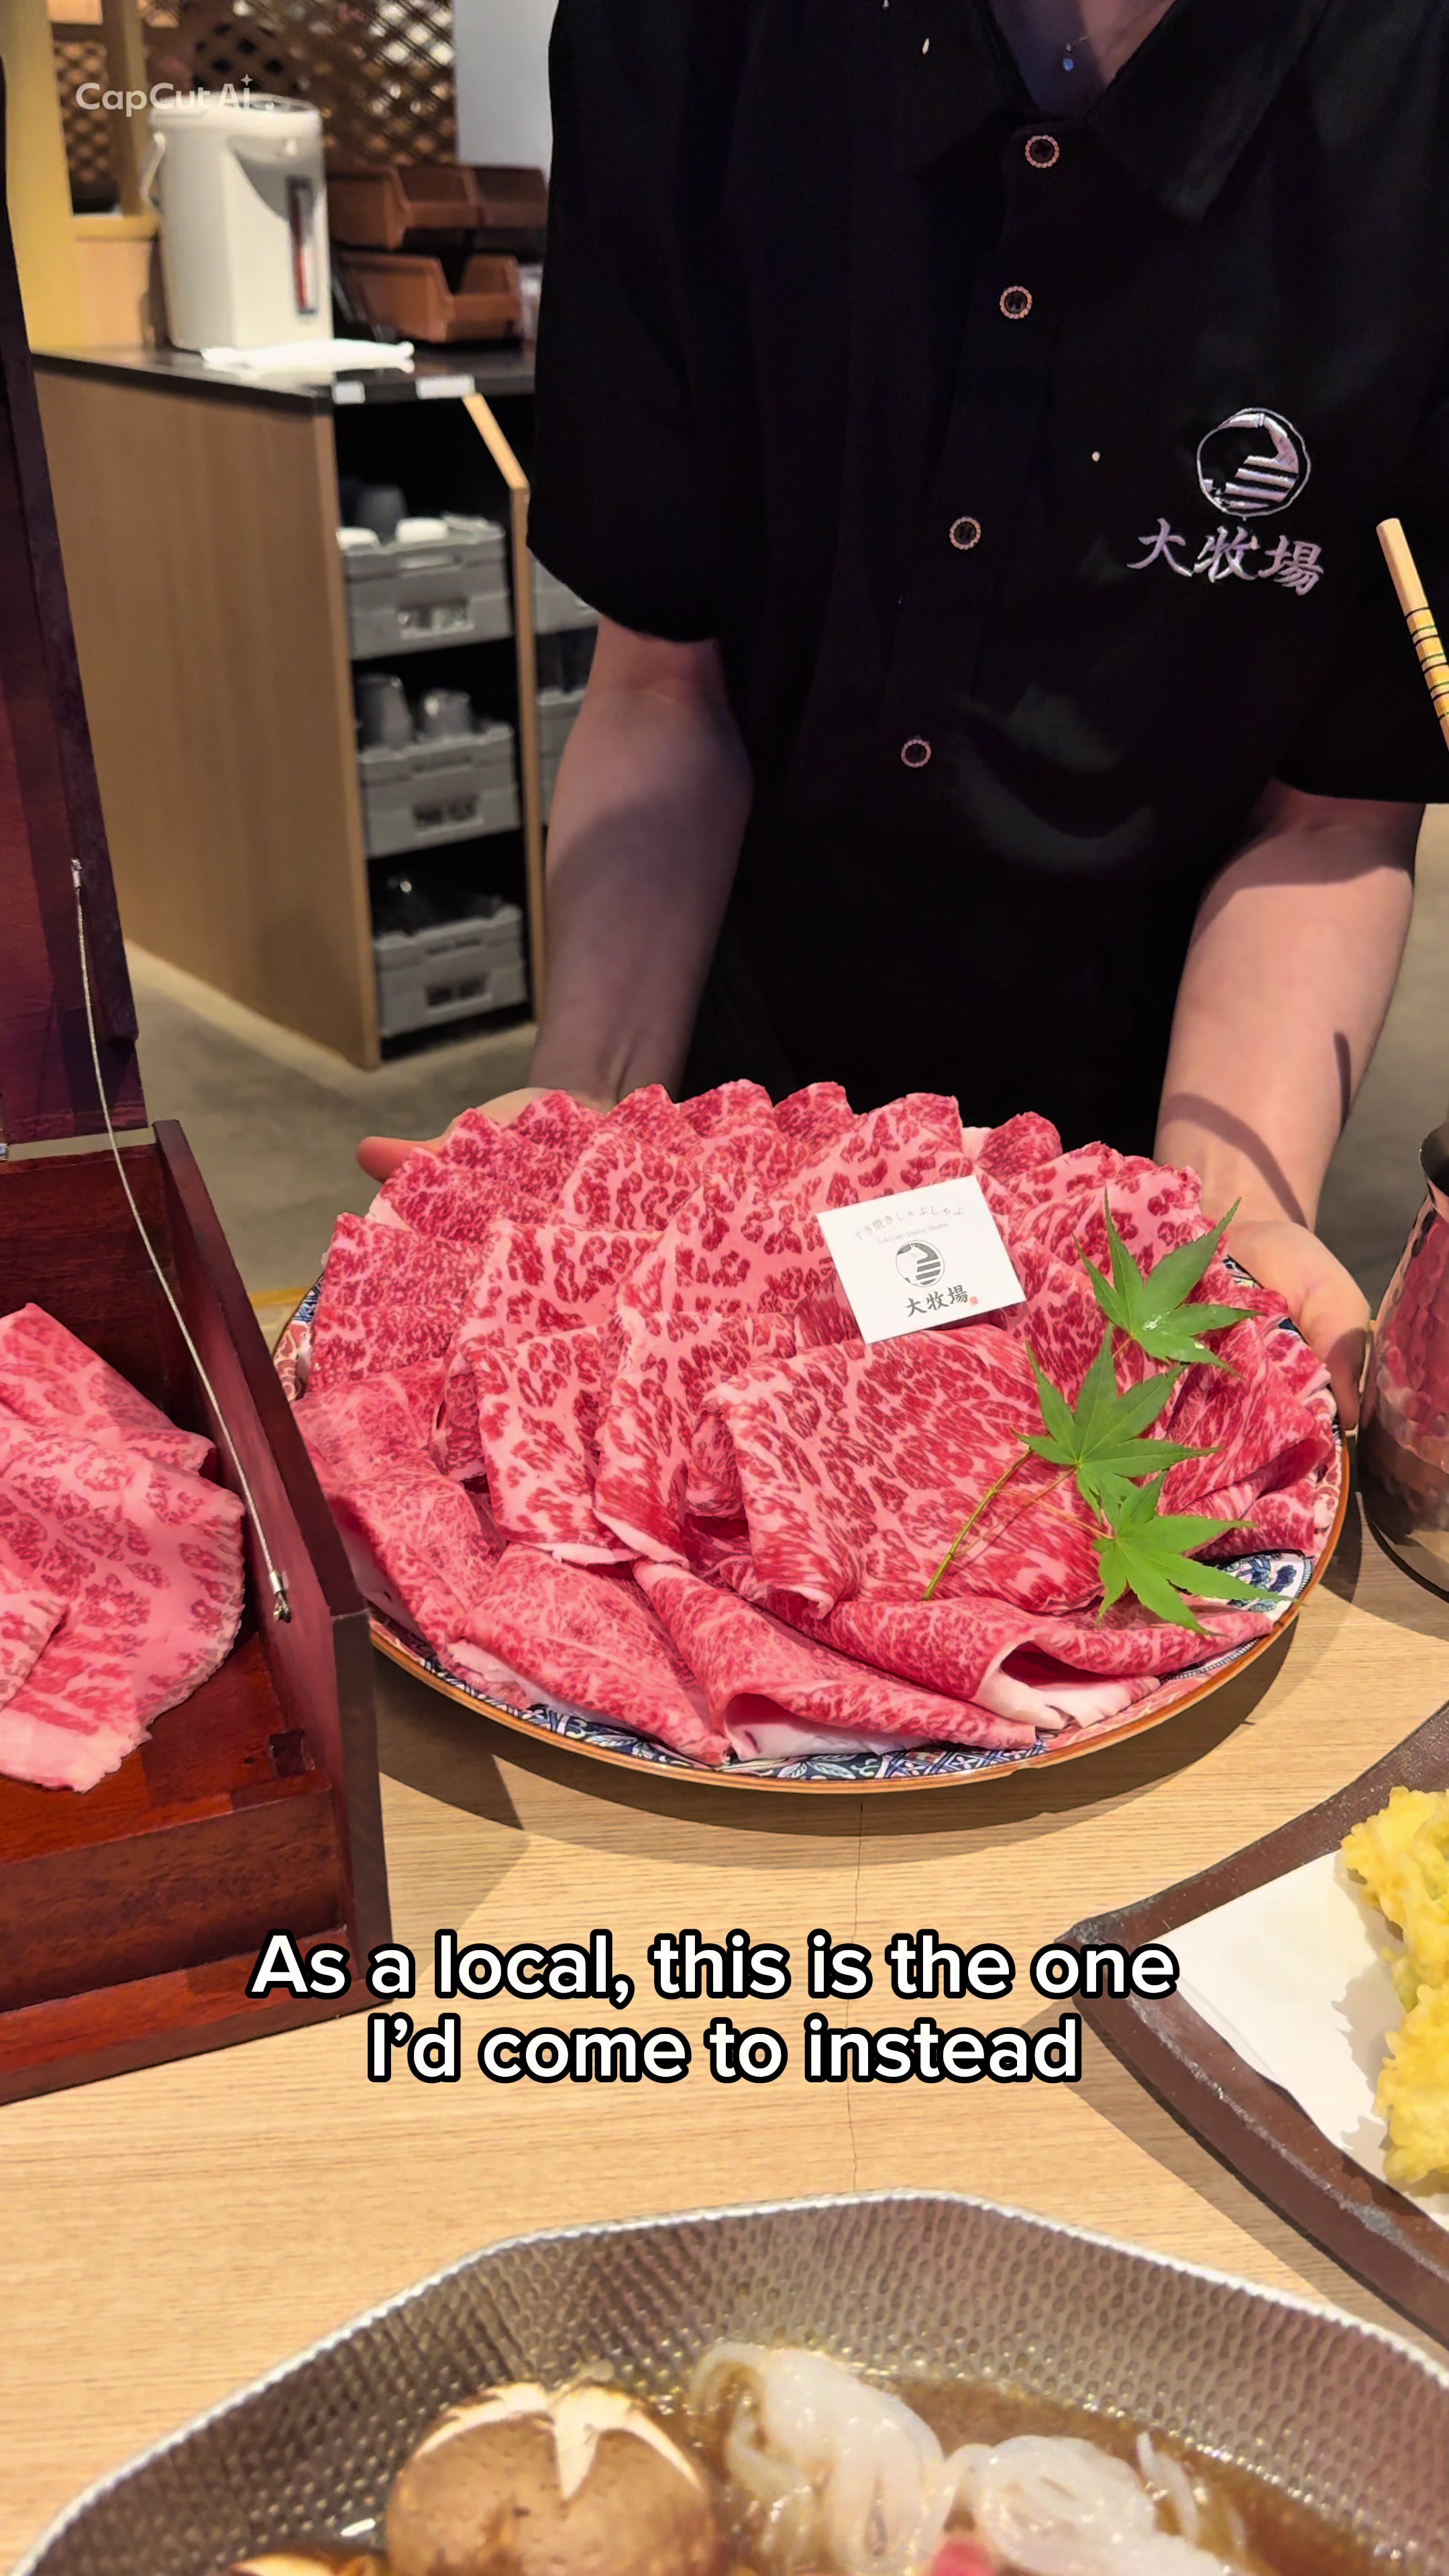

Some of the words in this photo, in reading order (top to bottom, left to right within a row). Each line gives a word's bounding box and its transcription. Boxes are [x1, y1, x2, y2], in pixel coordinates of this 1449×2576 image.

[1126, 517, 1325, 596] 大牧場
[906, 1284, 969, 1317] 大牧場
